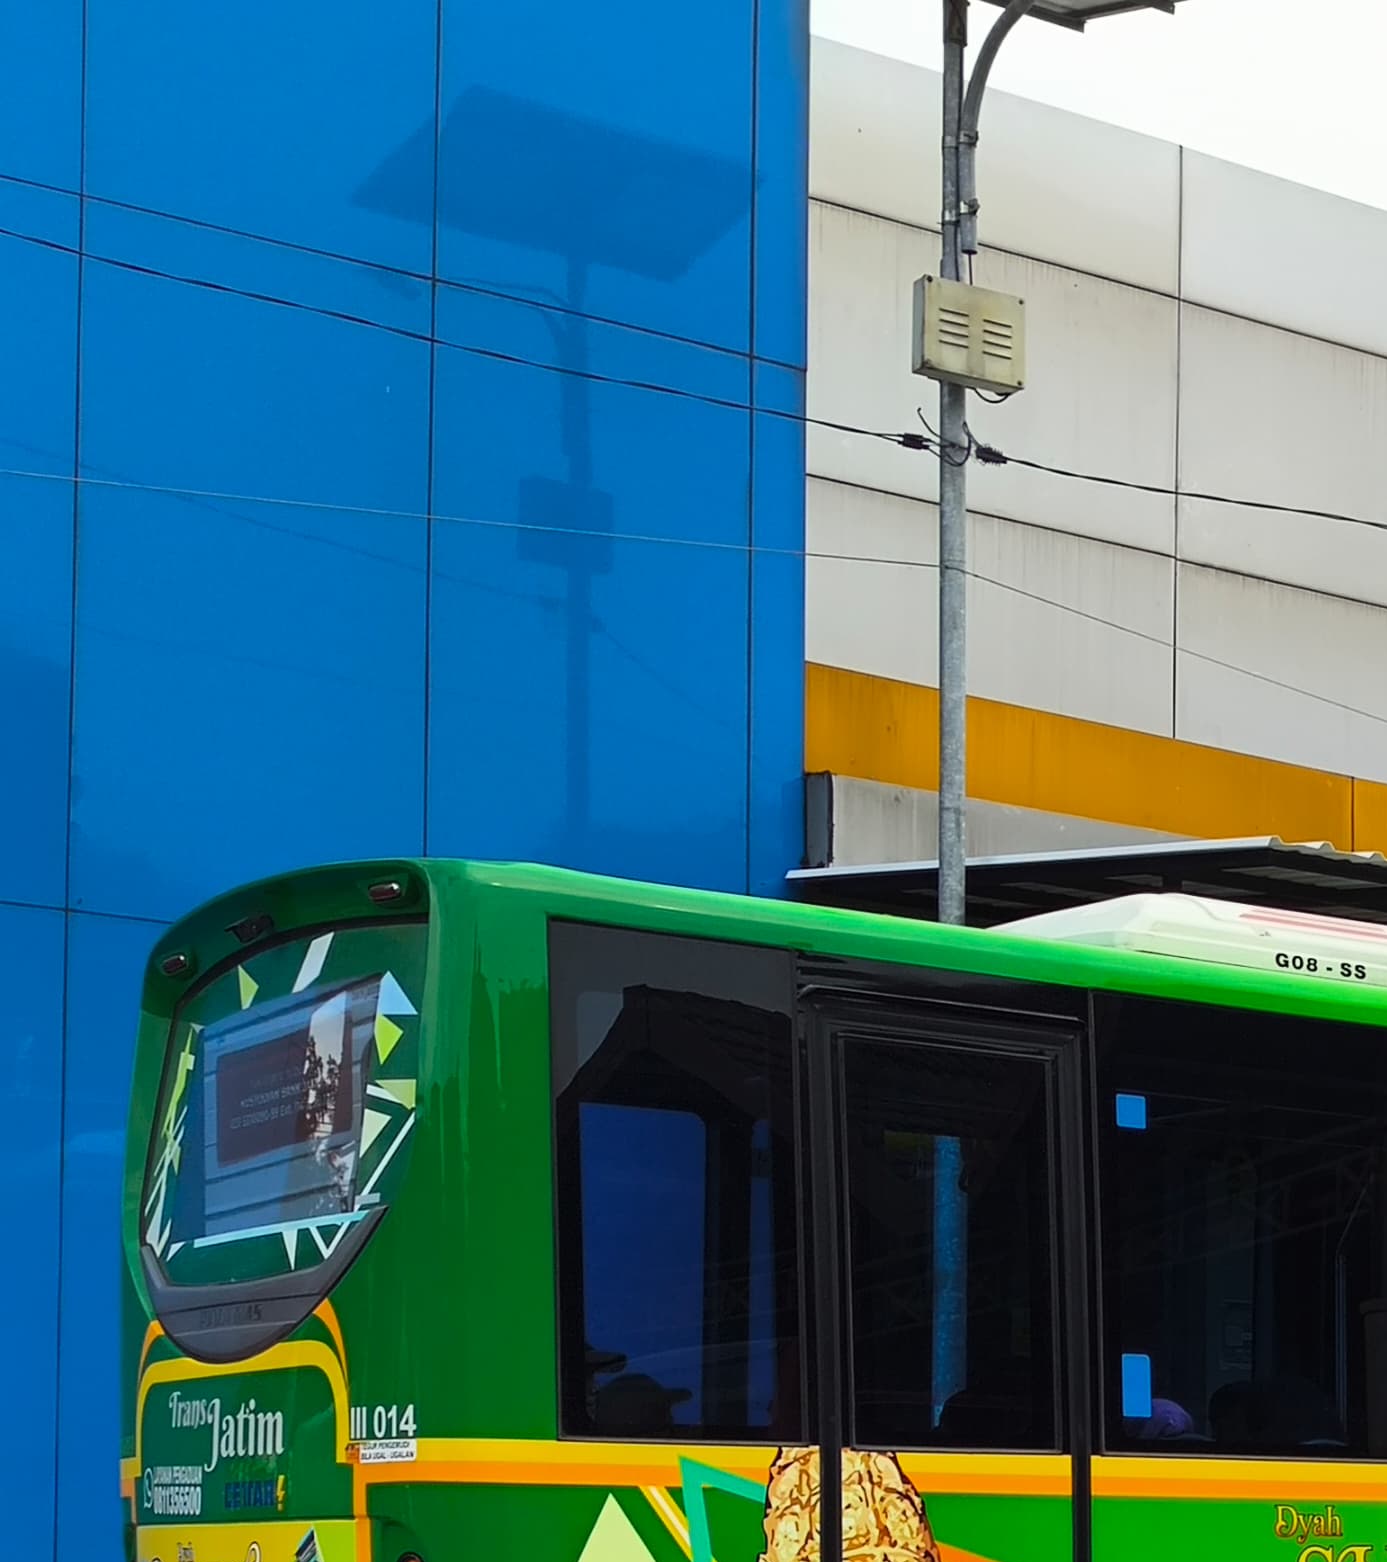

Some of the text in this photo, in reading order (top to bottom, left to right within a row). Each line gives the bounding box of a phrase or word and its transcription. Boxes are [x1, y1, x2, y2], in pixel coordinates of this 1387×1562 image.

[1339, 961, 1368, 980] SS
[169, 1391, 207, 1430] Trans
[373, 1404, 417, 1438] 014
[204, 1398, 284, 1473] Jatim
[1275, 1504, 1343, 1544] Dyah
